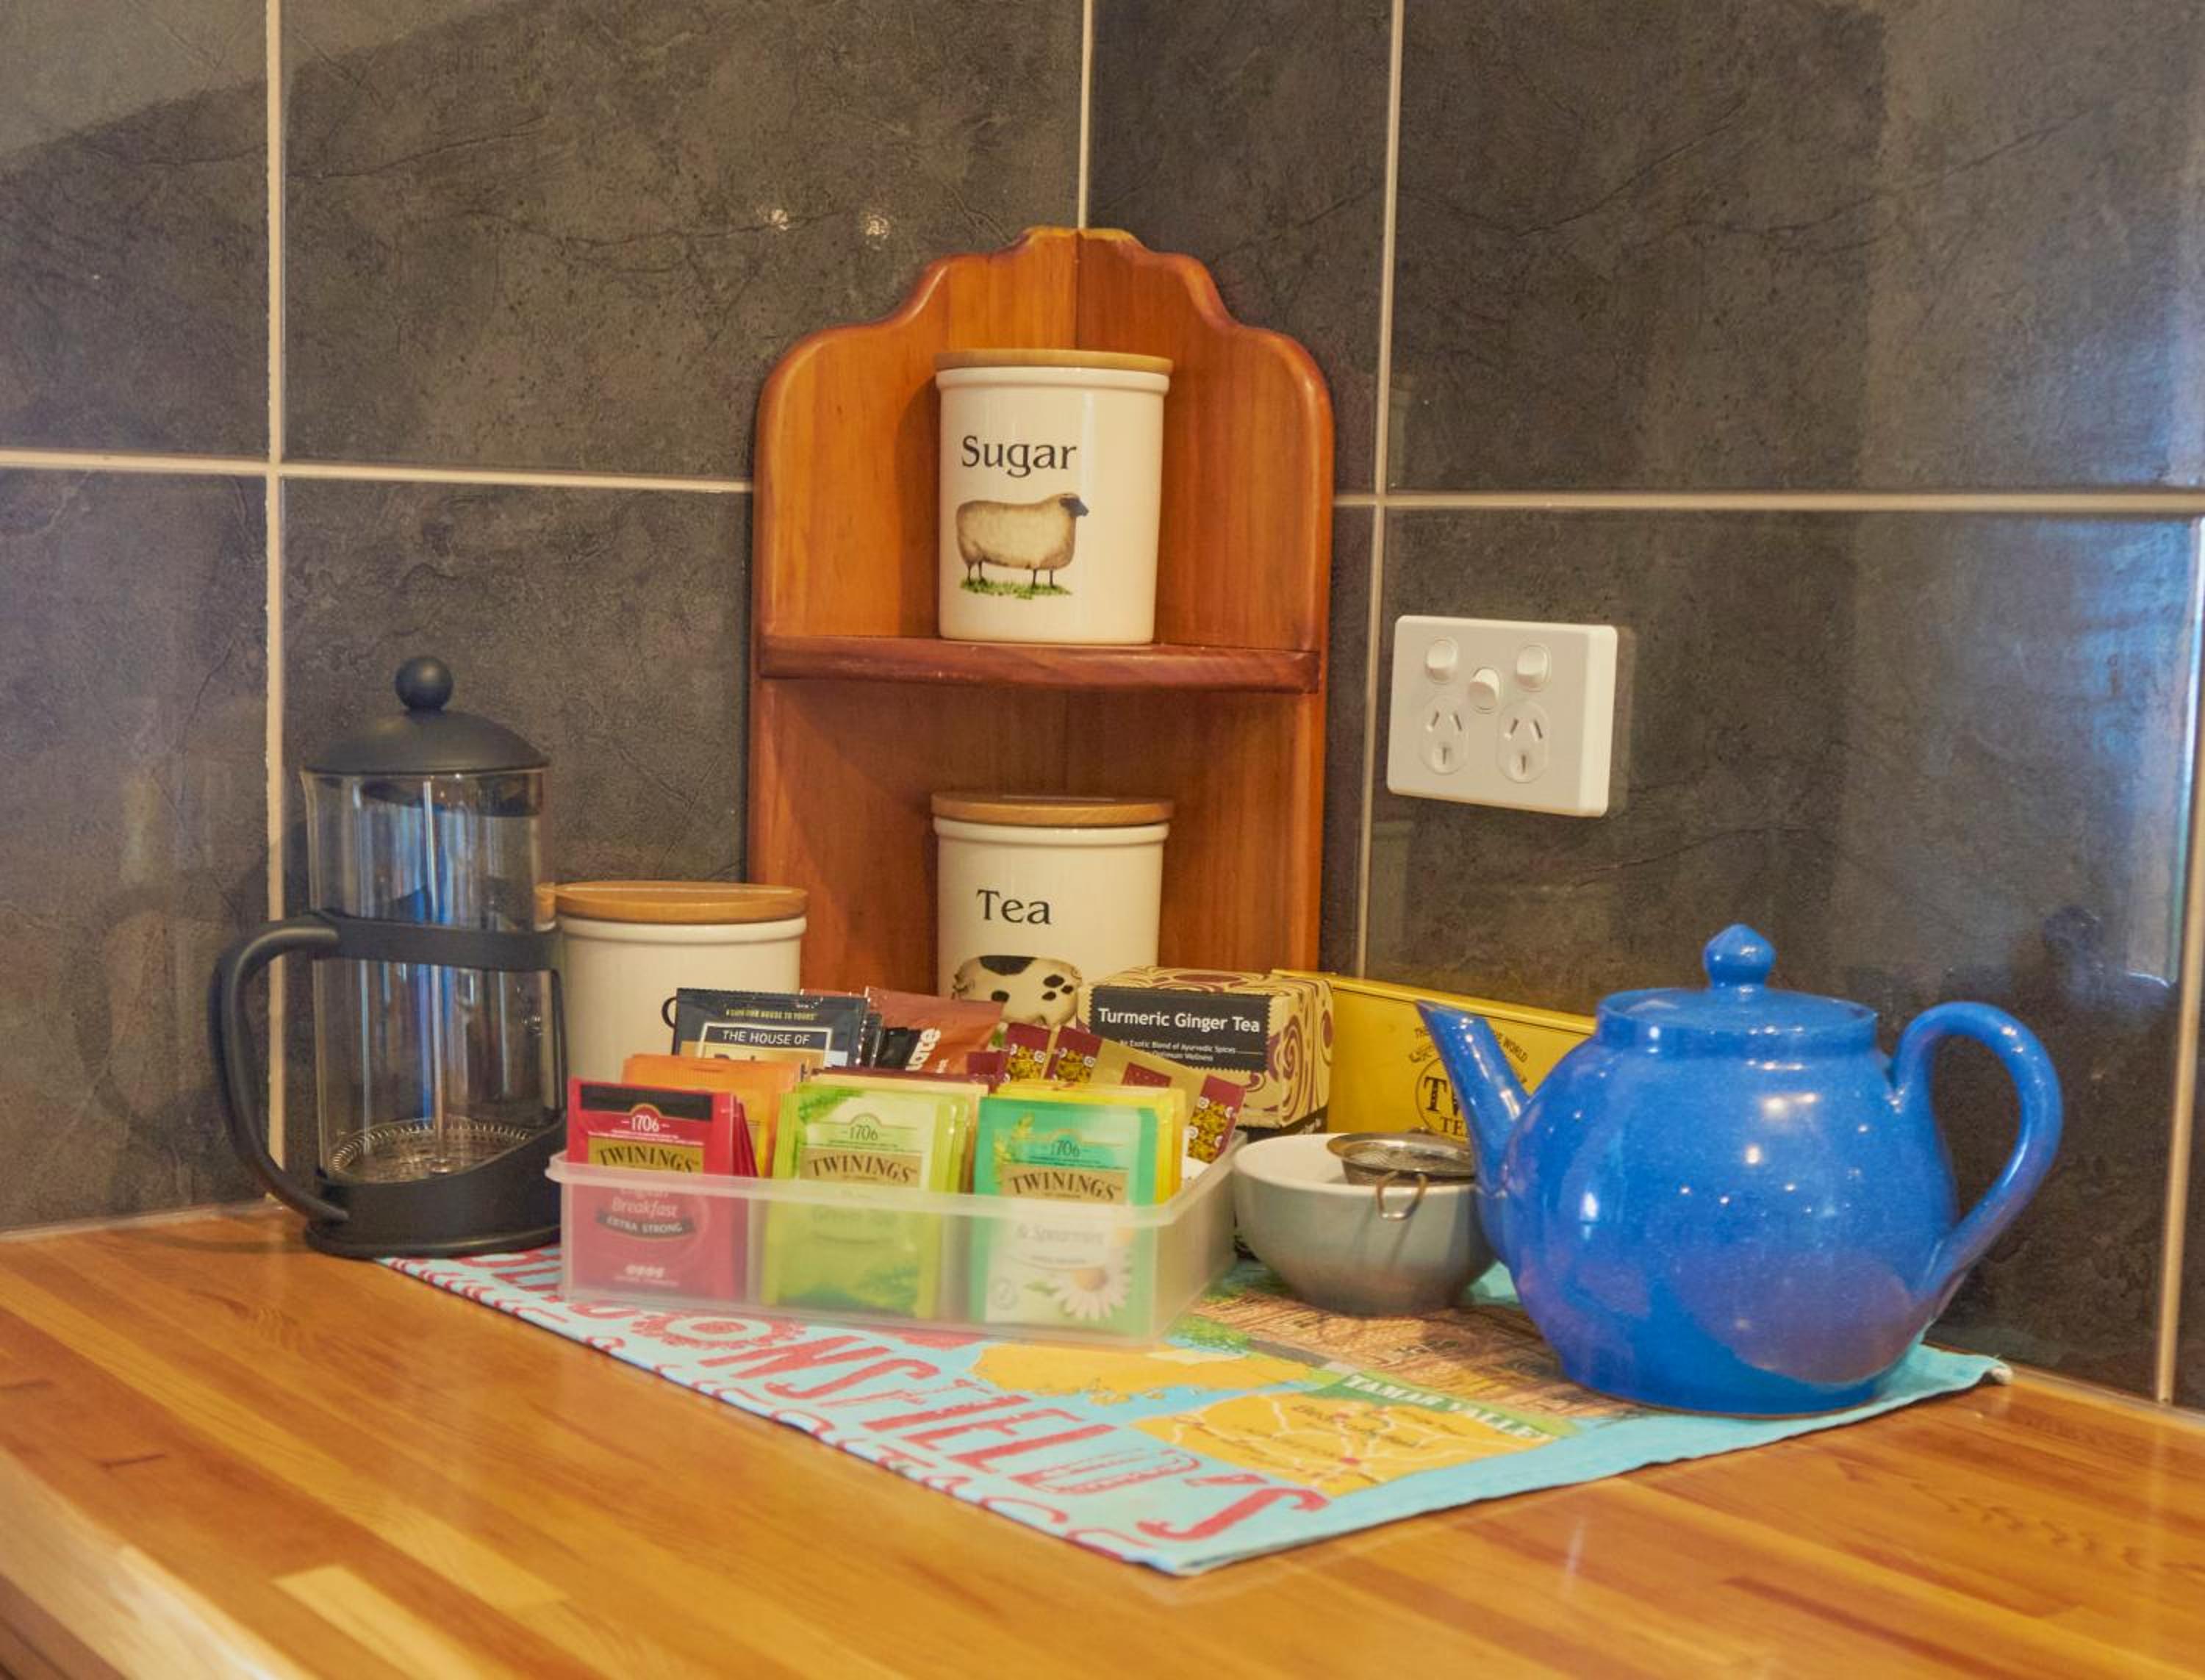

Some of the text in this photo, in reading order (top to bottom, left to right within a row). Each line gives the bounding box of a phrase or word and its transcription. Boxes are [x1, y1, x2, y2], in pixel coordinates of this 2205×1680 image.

[961, 434, 1077, 478] Sugar
[976, 889, 1052, 925] Tea
[1098, 1008, 1261, 1033] Turmeric Ginger Tea
[723, 1030, 811, 1046] THE HOUSE OF
[1130, 1040, 1150, 1049] Exotic
[1152, 1041, 1172, 1050] Blend
[1180, 1043, 1213, 1053] Ayurvedic
[1214, 1045, 1236, 1054] Spices
[1503, 1037, 1527, 1063] WORLD
[1185, 1052, 1213, 1061] Wellness
[632, 1114, 660, 1132] 1706
[850, 1124, 878, 1141] 1706
[599, 1145, 695, 1173] TWININGS
[809, 1155, 911, 1183] TWININGS
[1009, 1171, 1116, 1201] TWININGS
[612, 1197, 678, 1218] Breakfast
[606, 1213, 683, 1234] EXTRA STRONG
[1343, 1373, 1446, 1405] TAMAR
[1448, 1401, 1553, 1442] VALLEY
